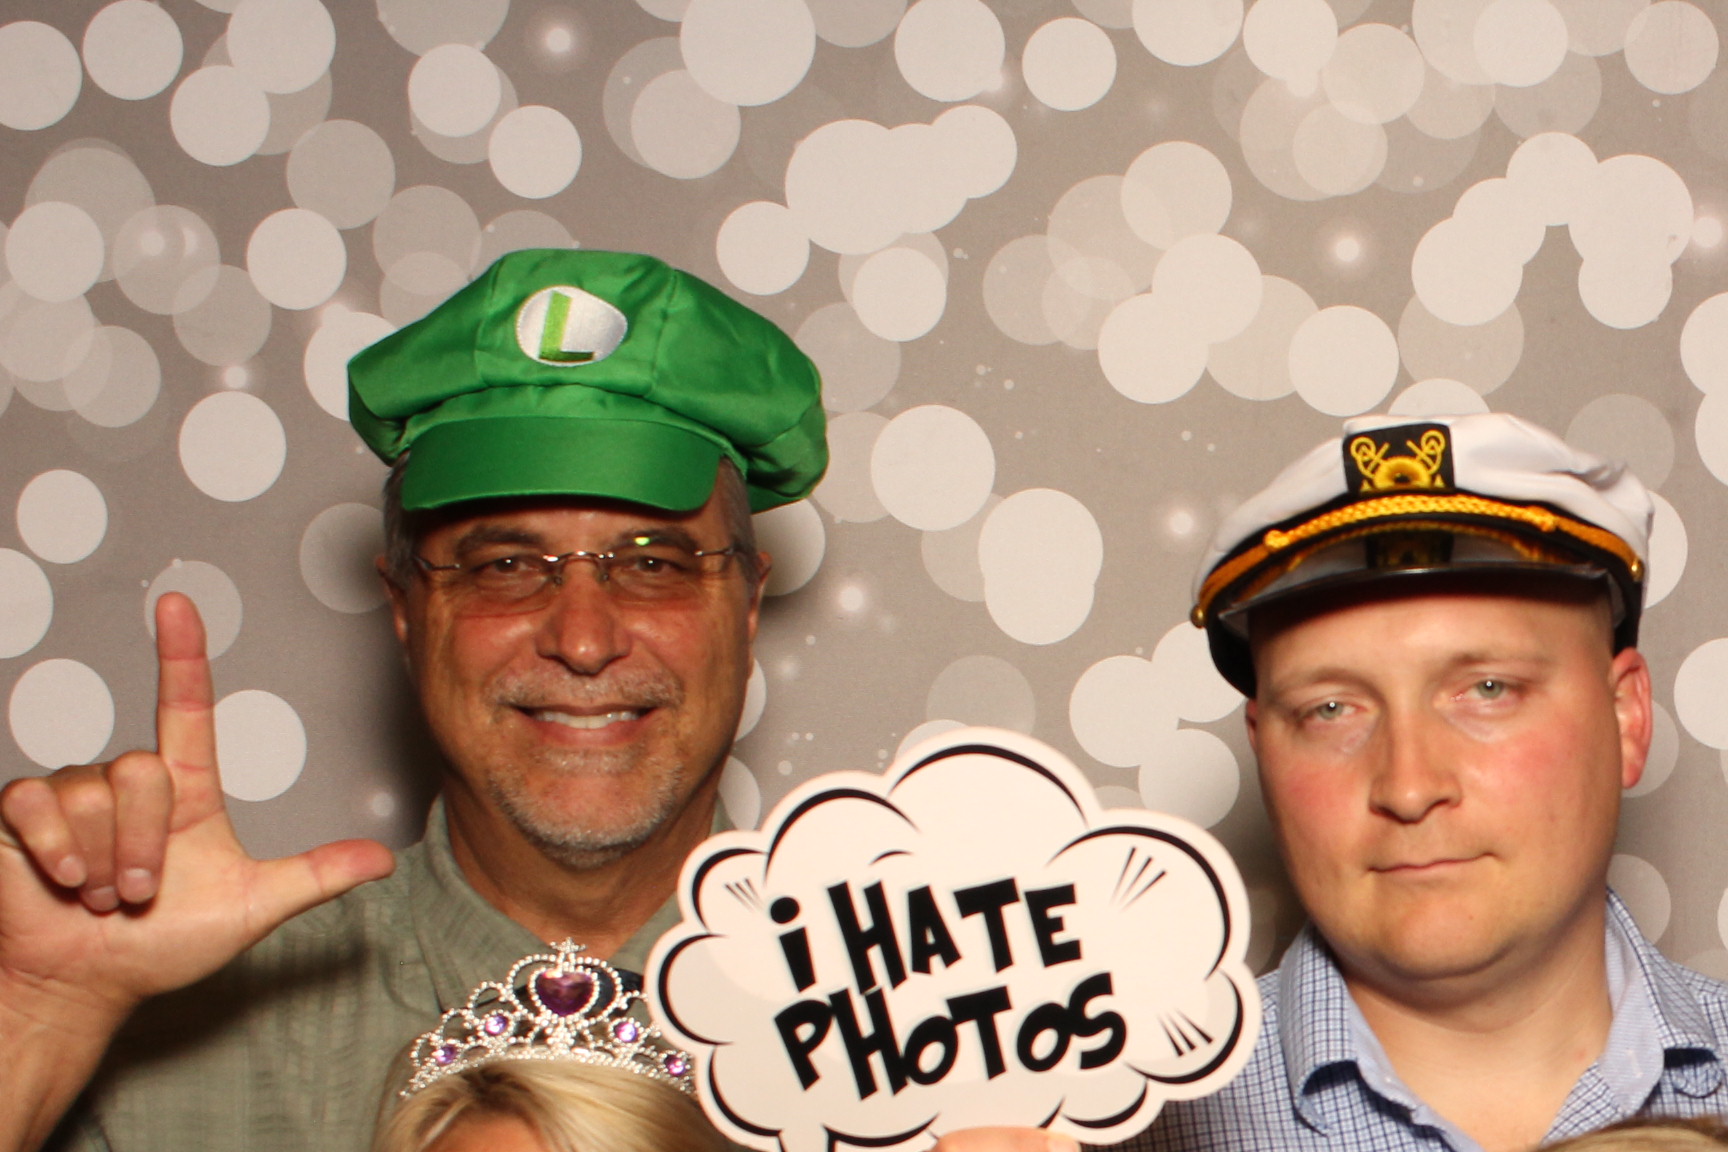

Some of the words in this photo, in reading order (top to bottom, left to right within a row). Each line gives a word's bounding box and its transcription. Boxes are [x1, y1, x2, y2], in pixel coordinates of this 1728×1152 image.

[538, 290, 595, 363] L
[827, 877, 1083, 997] HATE
[774, 972, 1127, 1101] PHOTOS
